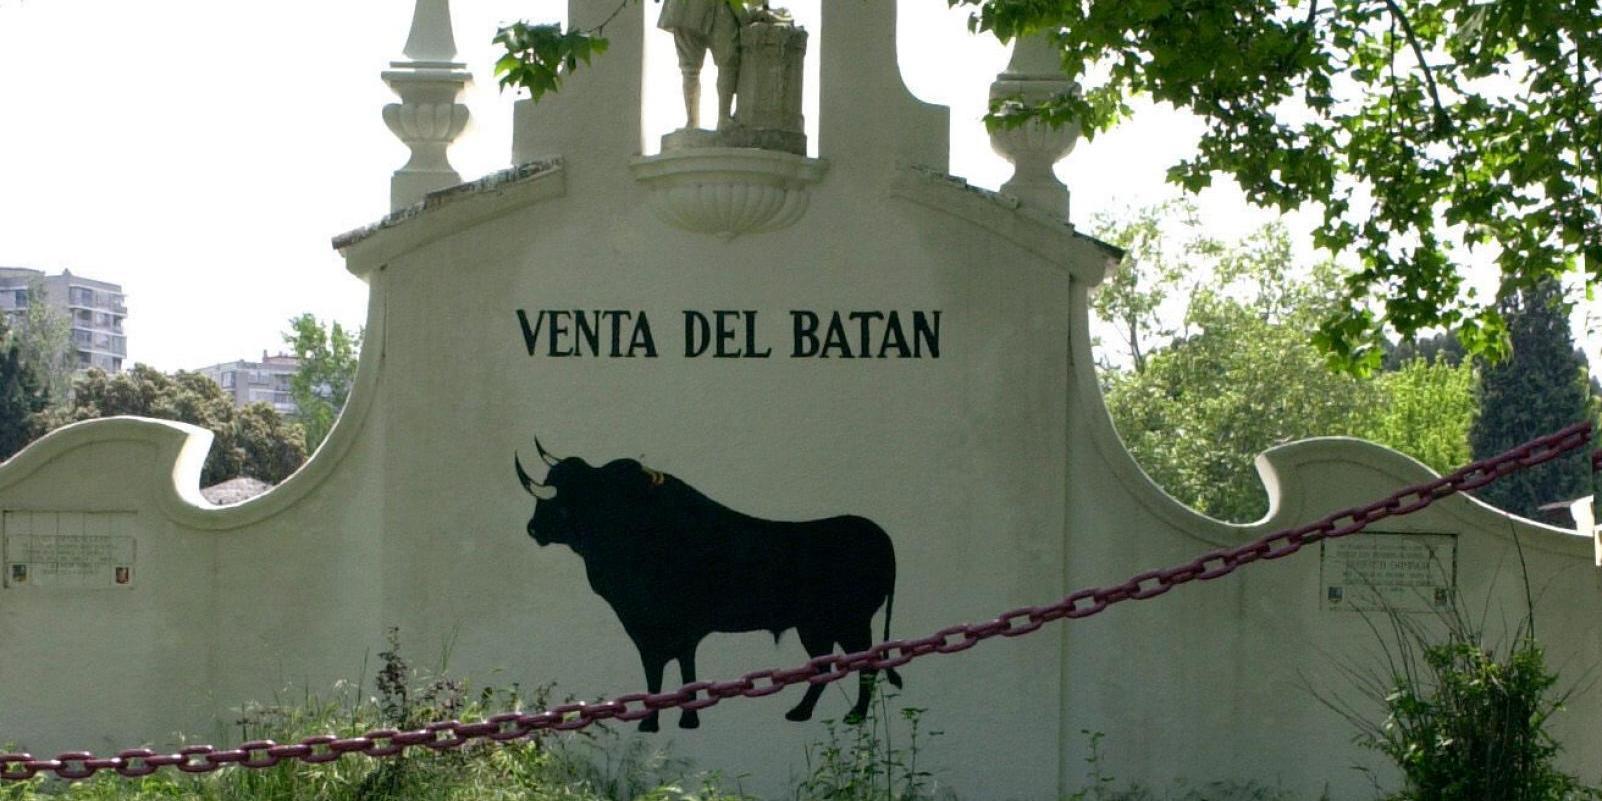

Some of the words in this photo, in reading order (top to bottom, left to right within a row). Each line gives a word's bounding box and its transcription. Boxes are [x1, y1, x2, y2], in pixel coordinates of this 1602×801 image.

[516, 309, 658, 359] VENTA
[683, 309, 772, 359] DEL
[789, 309, 942, 360] BATAN
